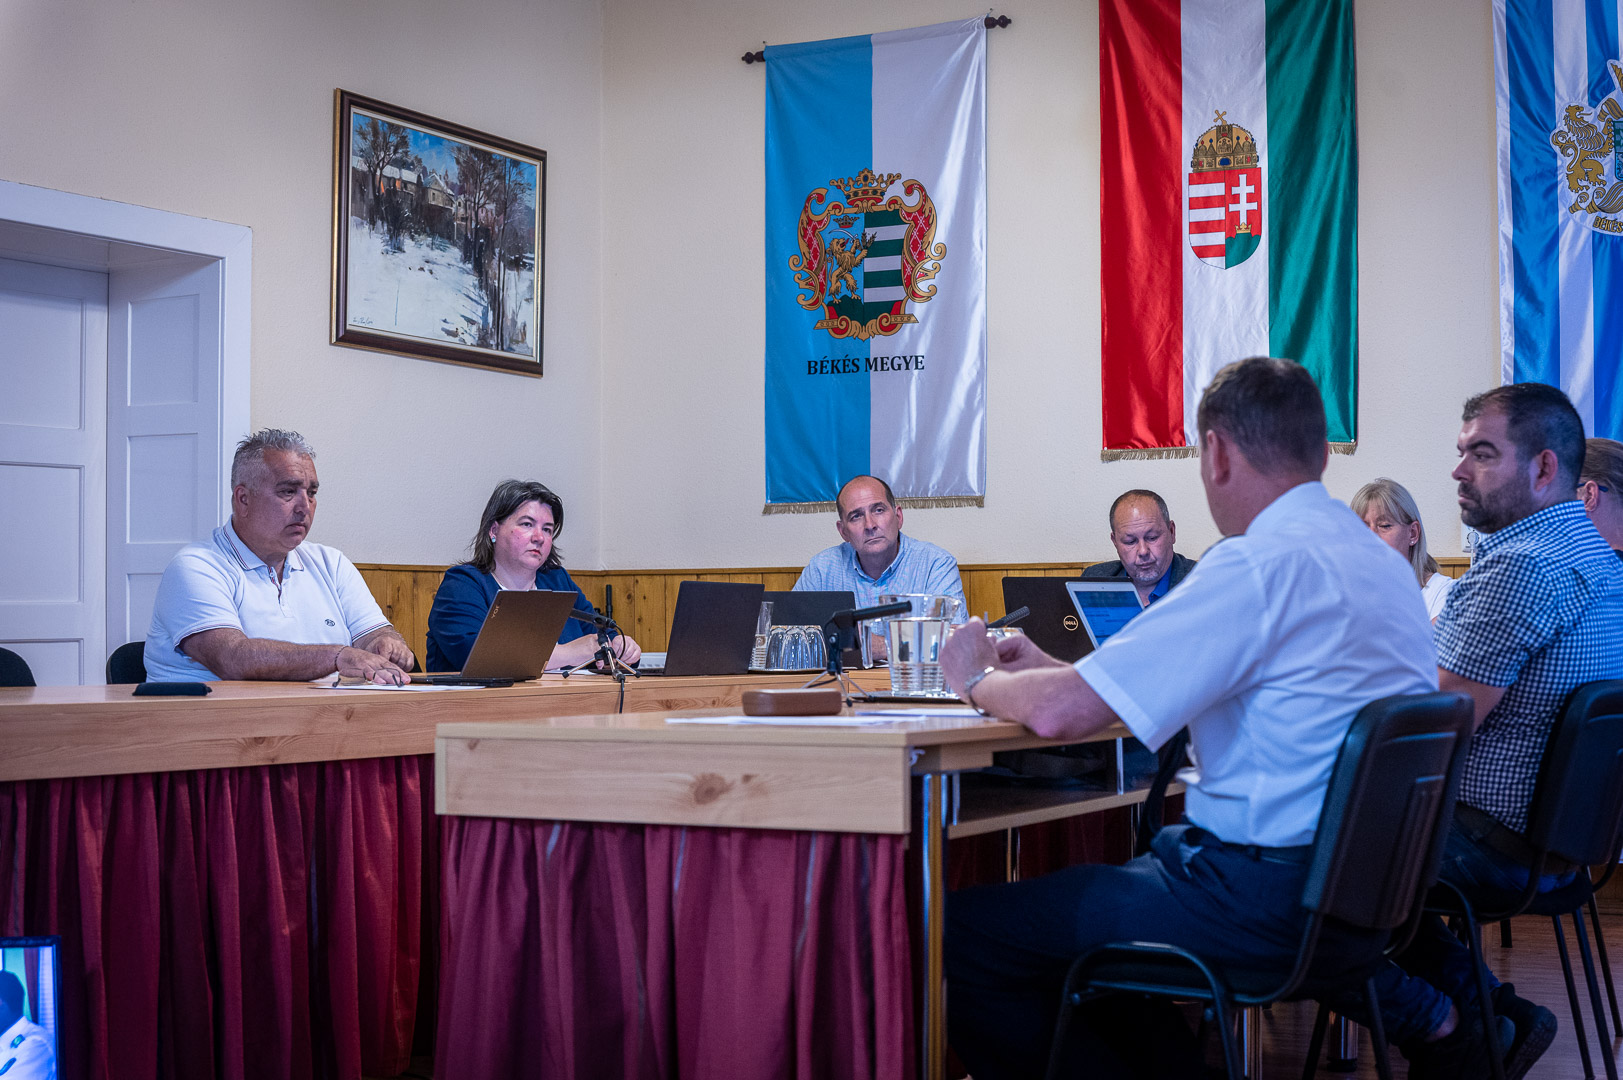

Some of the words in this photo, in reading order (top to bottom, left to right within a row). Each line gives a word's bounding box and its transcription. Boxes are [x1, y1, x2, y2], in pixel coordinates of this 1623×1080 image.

[1593, 215, 1623, 233] BÉKÉS
[807, 354, 860, 375] BÉKÉS
[864, 355, 925, 372] MEGYE
